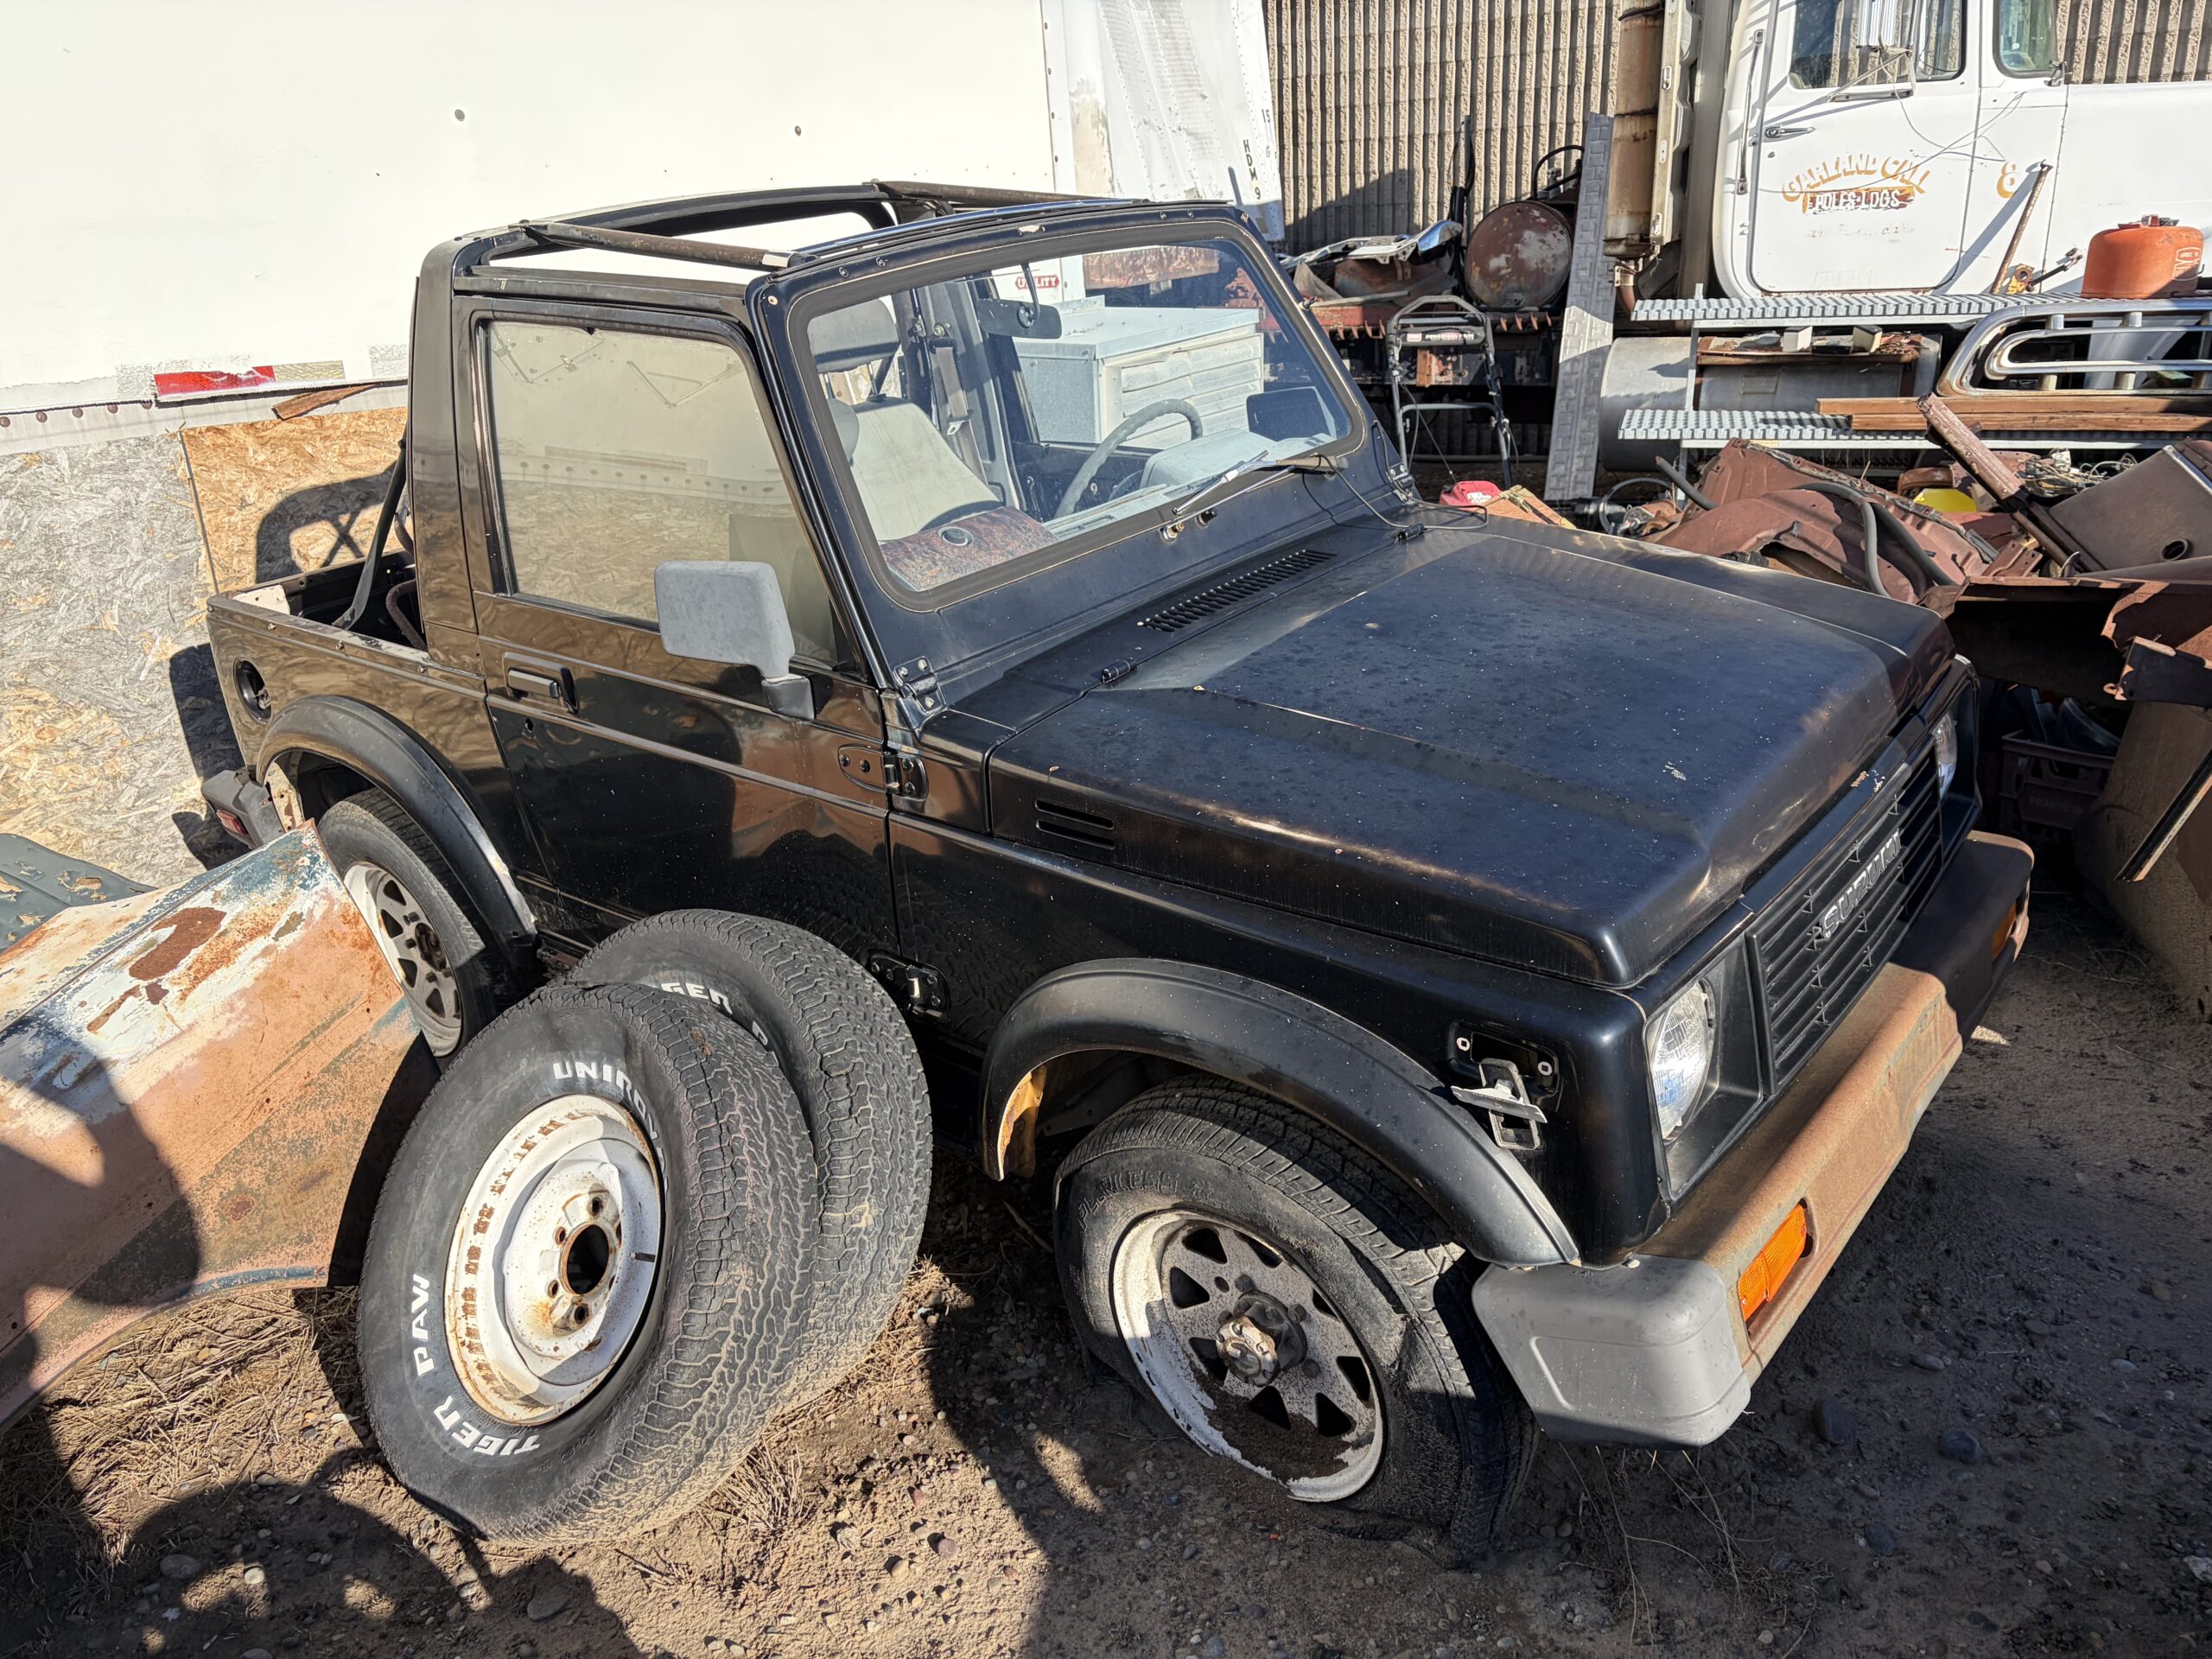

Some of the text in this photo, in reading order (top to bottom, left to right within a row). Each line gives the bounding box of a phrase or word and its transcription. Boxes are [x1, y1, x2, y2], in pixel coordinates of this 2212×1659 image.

[1017, 276, 1057, 289] ULITY
[1821, 828, 1901, 939] SUZUKI
[661, 982, 733, 1014] GER
[411, 1274, 540, 1455] TIGER PAW
